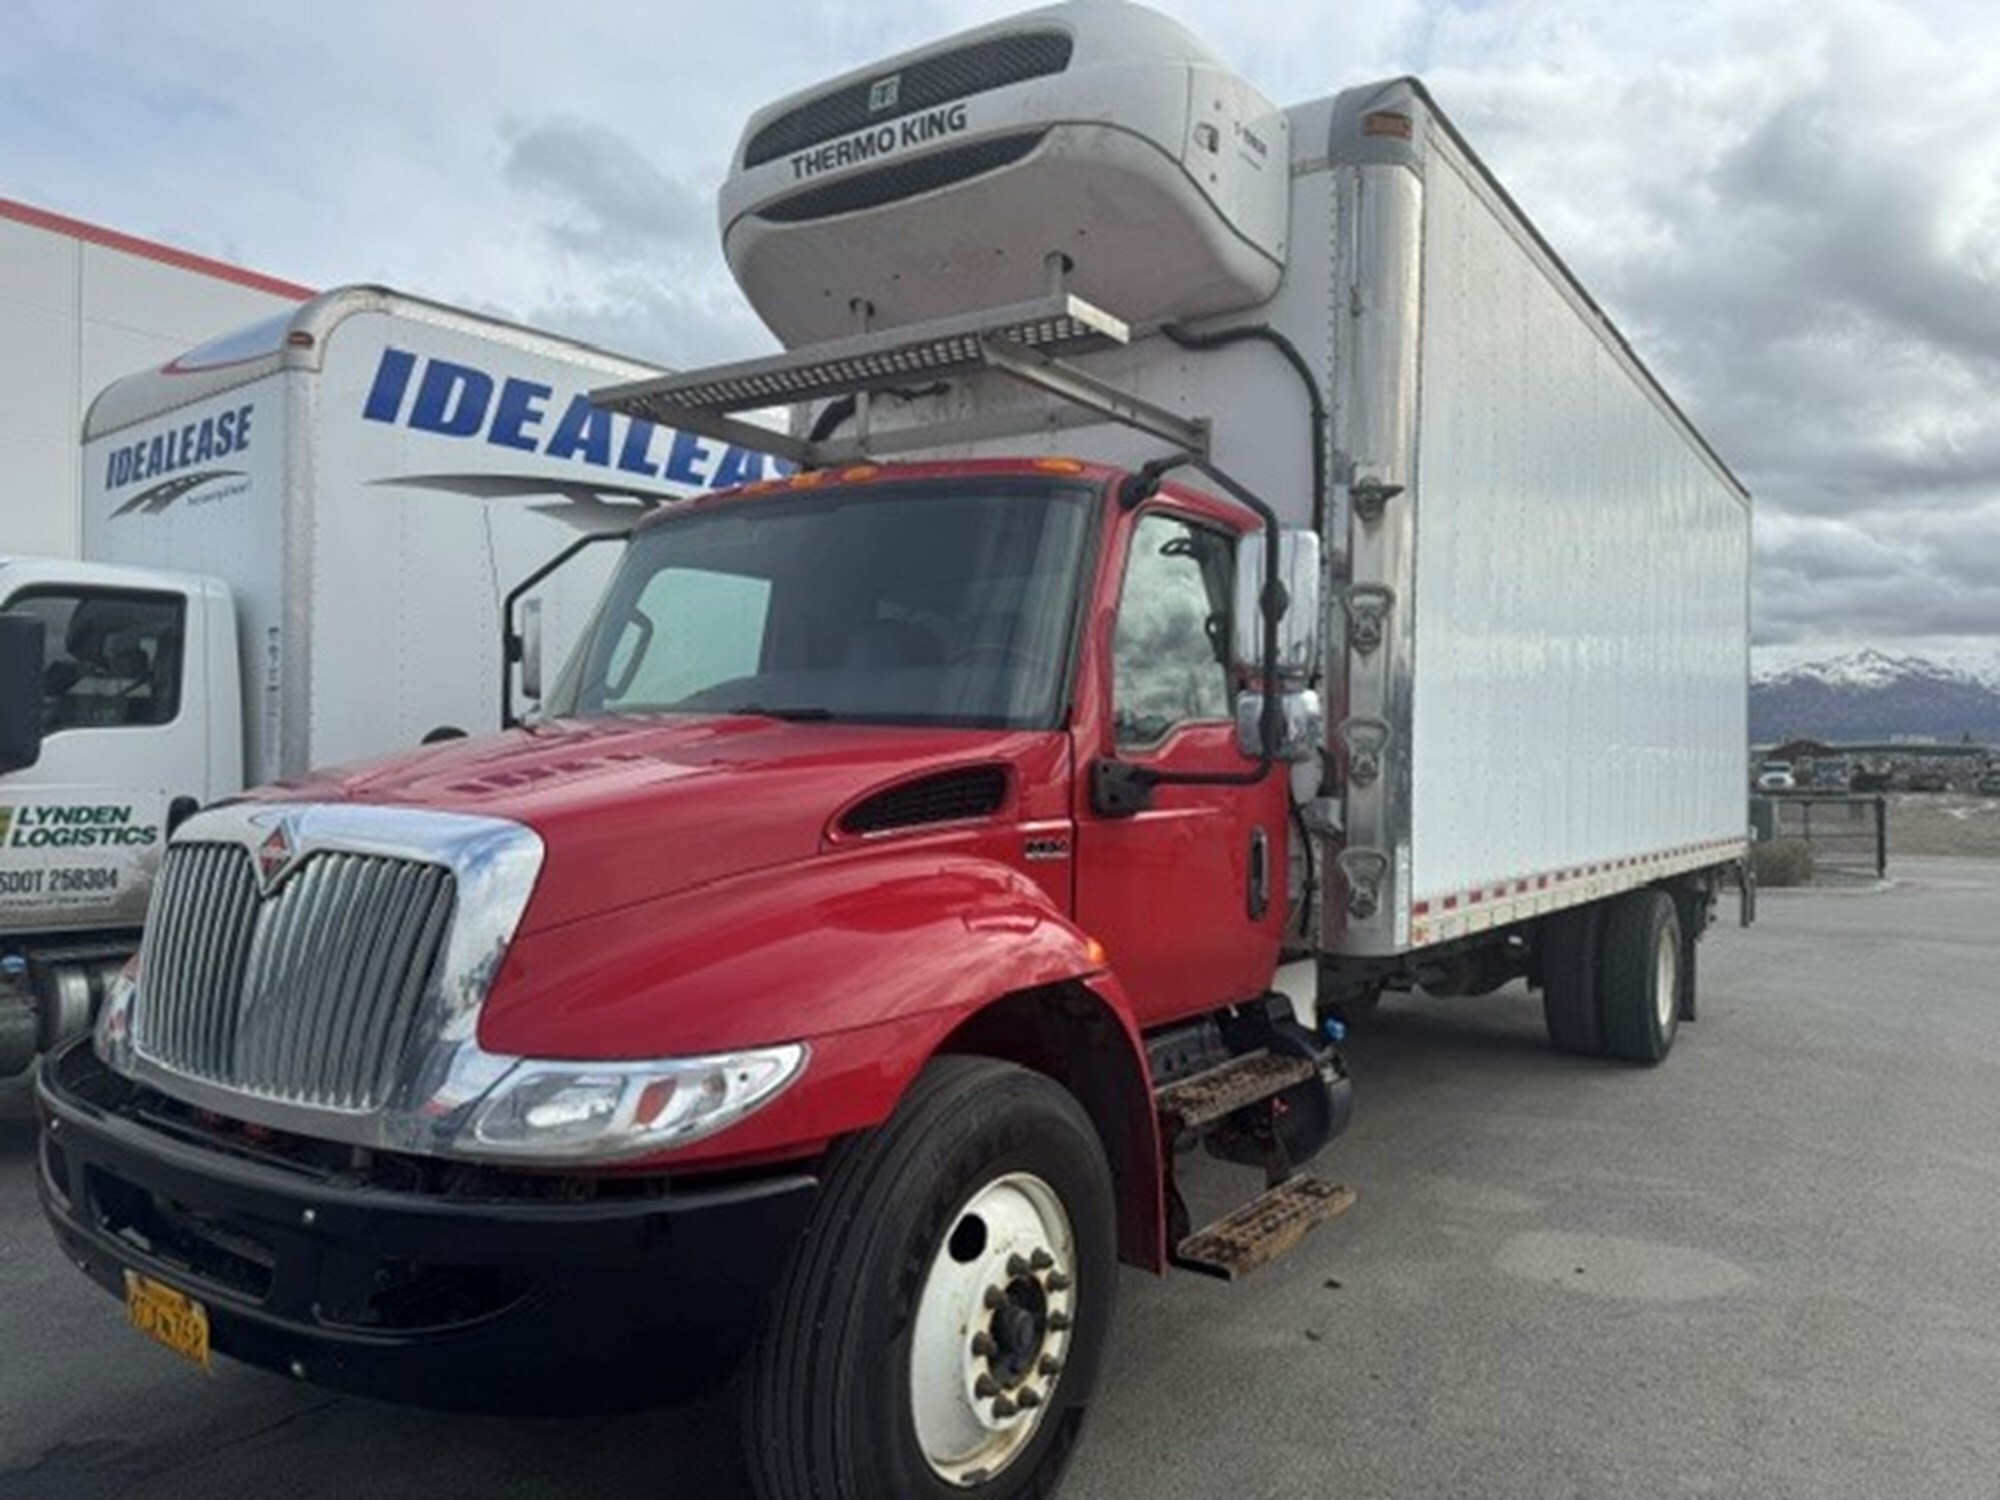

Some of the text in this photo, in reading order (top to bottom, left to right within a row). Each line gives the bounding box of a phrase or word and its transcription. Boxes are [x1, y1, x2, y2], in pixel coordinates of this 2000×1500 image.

[791, 103, 967, 179] THERMO KING
[105, 403, 254, 491] IDEALEASE
[11, 825, 158, 848] LOGISTICS
[17, 805, 132, 826] LYNDEN
